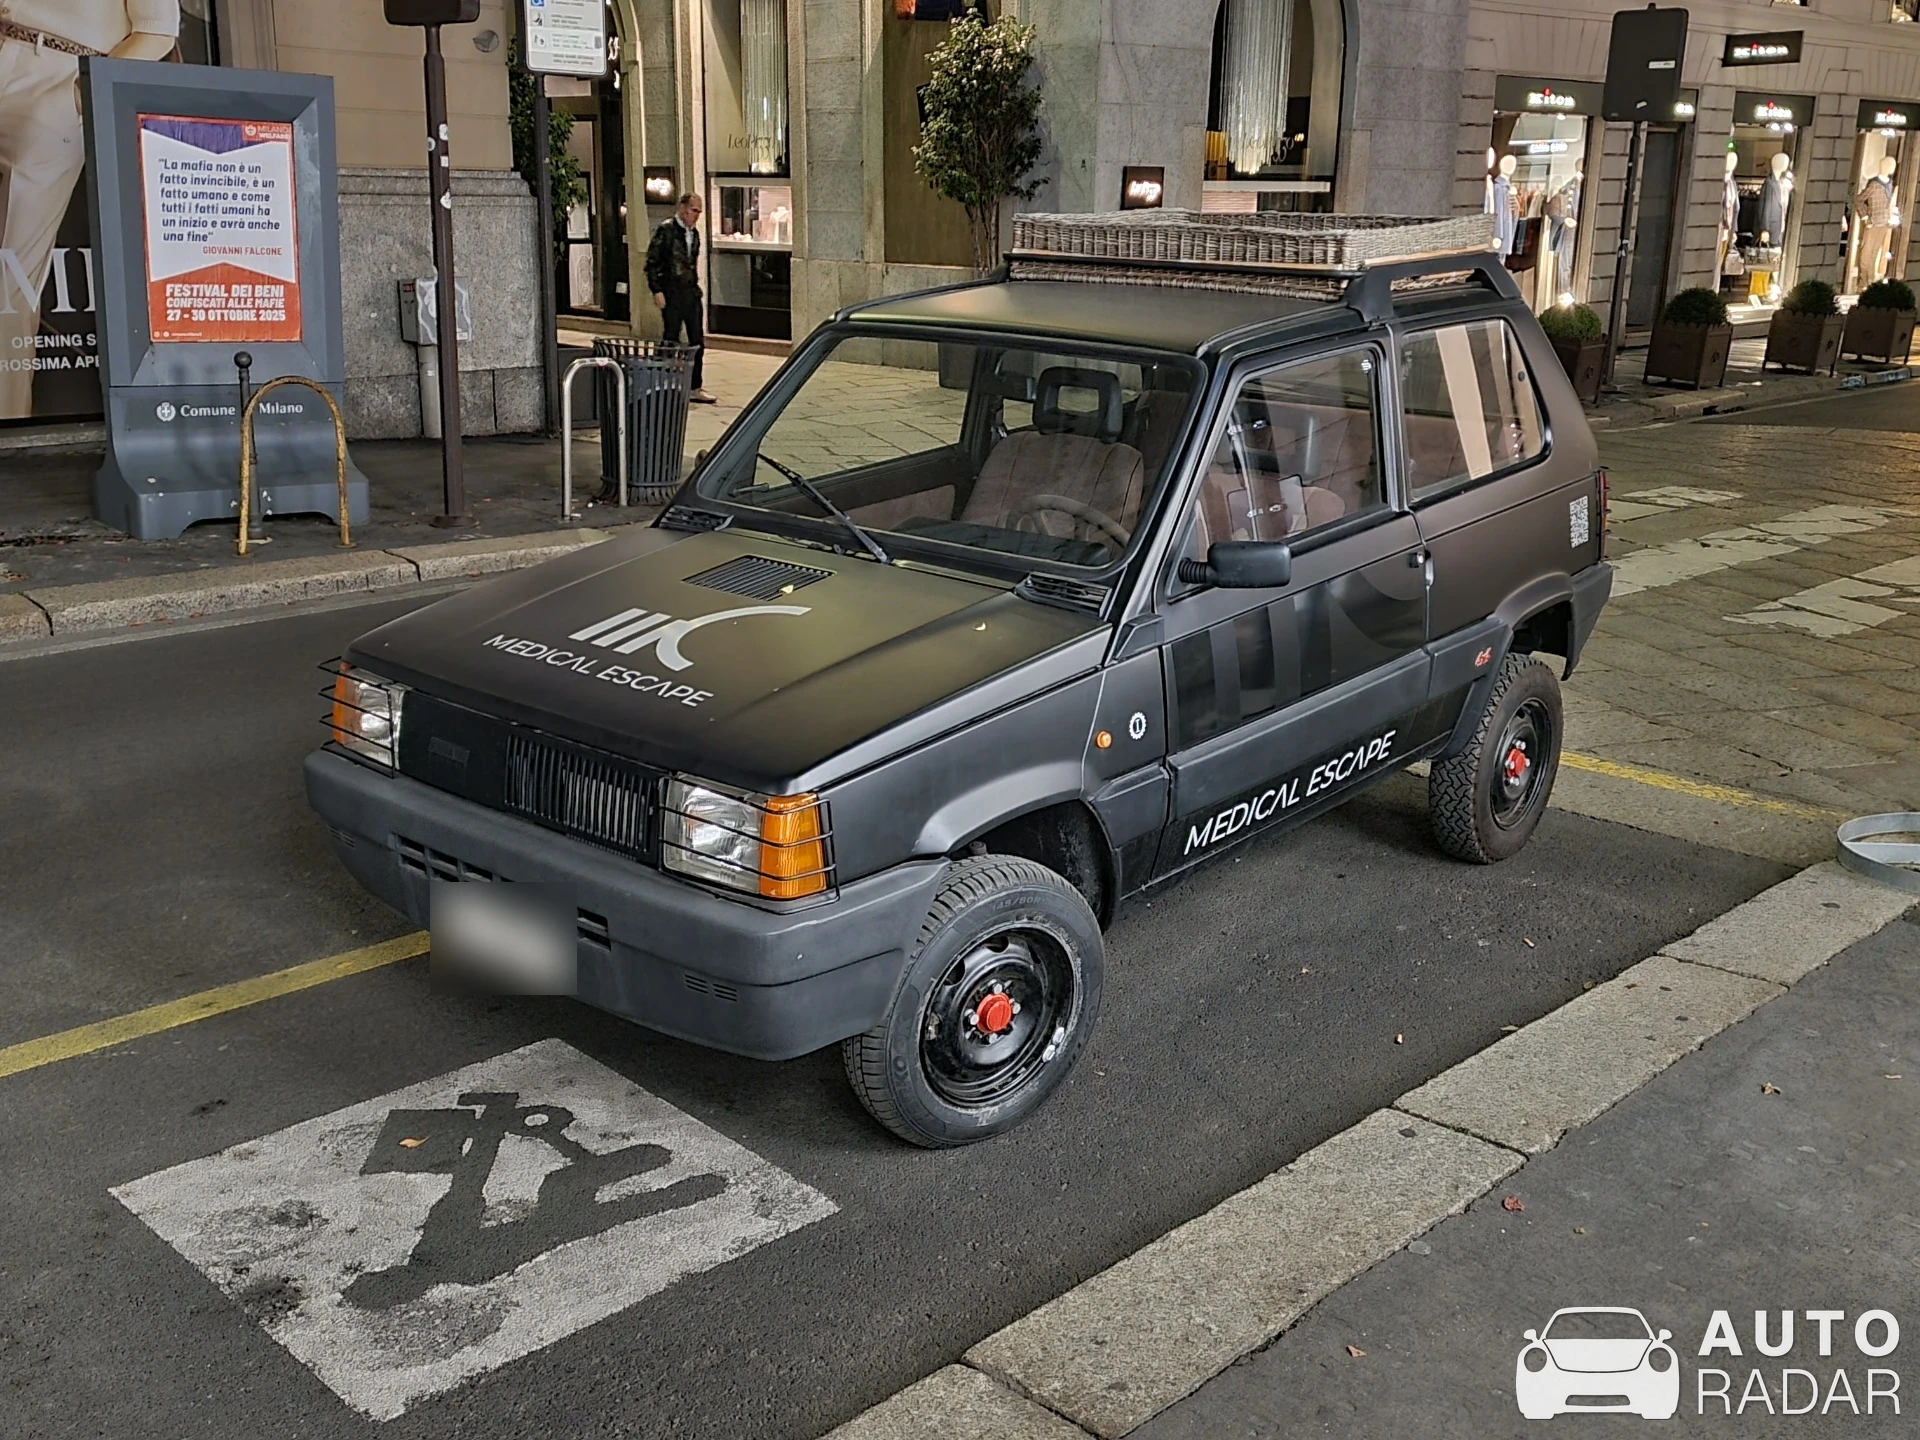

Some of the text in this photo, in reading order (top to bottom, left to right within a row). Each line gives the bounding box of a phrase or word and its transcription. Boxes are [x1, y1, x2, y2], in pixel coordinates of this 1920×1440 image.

[181, 160, 213, 171] mafia
[216, 162, 236, 172] non
[239, 161, 245, 173] è
[248, 164, 261, 174] un
[159, 173, 275, 189] fatto invincibile, è un
[160, 187, 270, 202] fatto umano e come
[161, 202, 185, 213] tutti
[194, 203, 219, 214] fatti
[221, 204, 255, 215] umani
[257, 205, 271, 216] ha
[162, 217, 280, 230] un inizio e avrà anche
[163, 232, 184, 242] una
[203, 246, 283, 256] GIOVANNI FALCONE
[165, 283, 284, 298] FESTIVAL DEI BENI
[166, 298, 285, 309] CONFISCATI ALLE MAFIE
[166, 309, 181, 321] 27
[191, 309, 206, 321] 30
[207, 309, 257, 321] OTTOBRE
[259, 309, 286, 322] 2025
[11, 334, 83, 349] OPENING
[180, 402, 304, 418] Comune Milano
[482, 634, 714, 707] MEDICAL ESCAPE
[1183, 729, 1397, 856] MEDICAL ESCAPE
